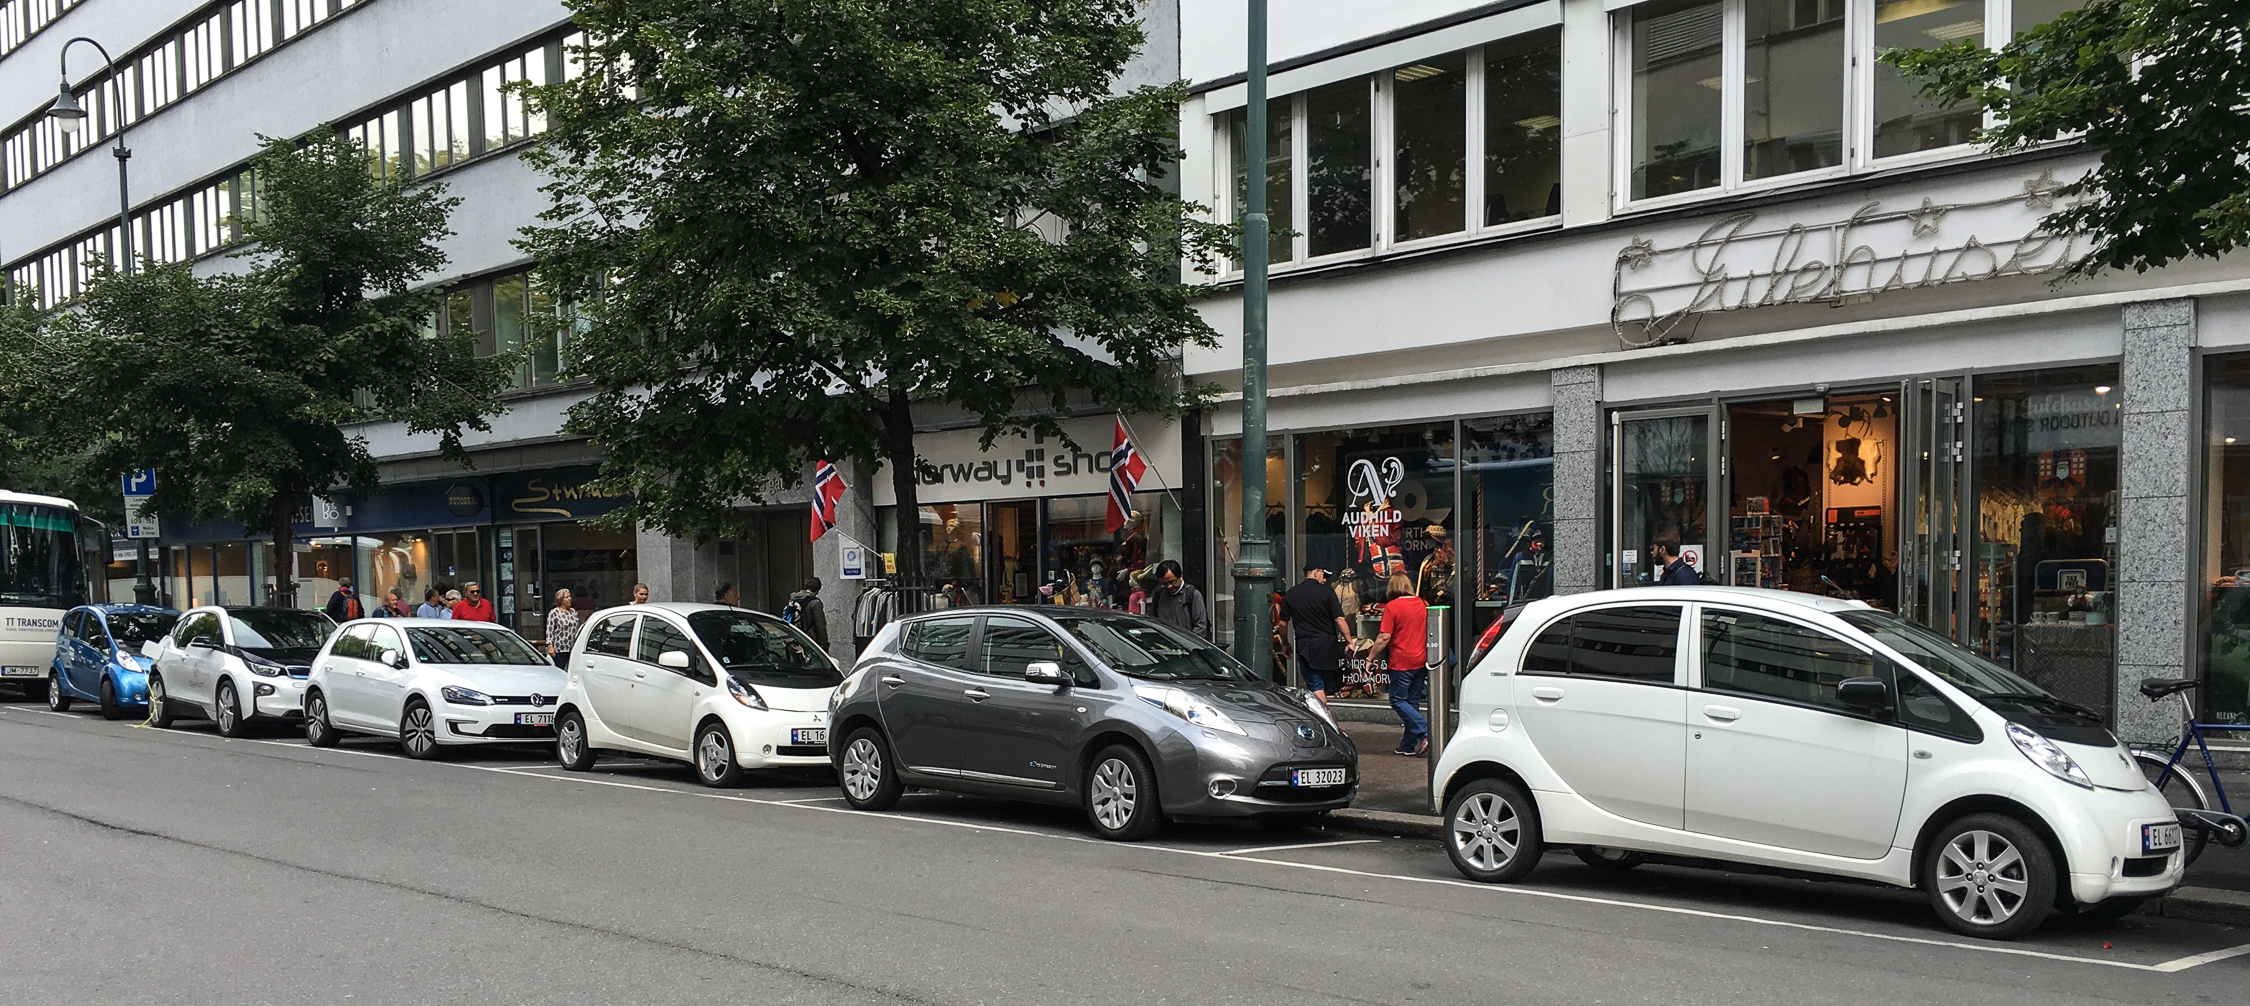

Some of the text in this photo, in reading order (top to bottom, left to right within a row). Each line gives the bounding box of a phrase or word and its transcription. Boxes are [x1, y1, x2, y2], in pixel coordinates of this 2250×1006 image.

[1053, 447, 1113, 476] sho
[131, 467, 147, 492] P
[1341, 510, 1402, 525] AUDHILD
[1348, 525, 1389, 538] VIKEN
[5, 617, 59, 628] TT TRANSCOM
[525, 714, 554, 724] EL 7118
[801, 730, 811, 740] EL
[1301, 770, 1343, 784] EL 32023
[2153, 828, 2162, 846] EL
